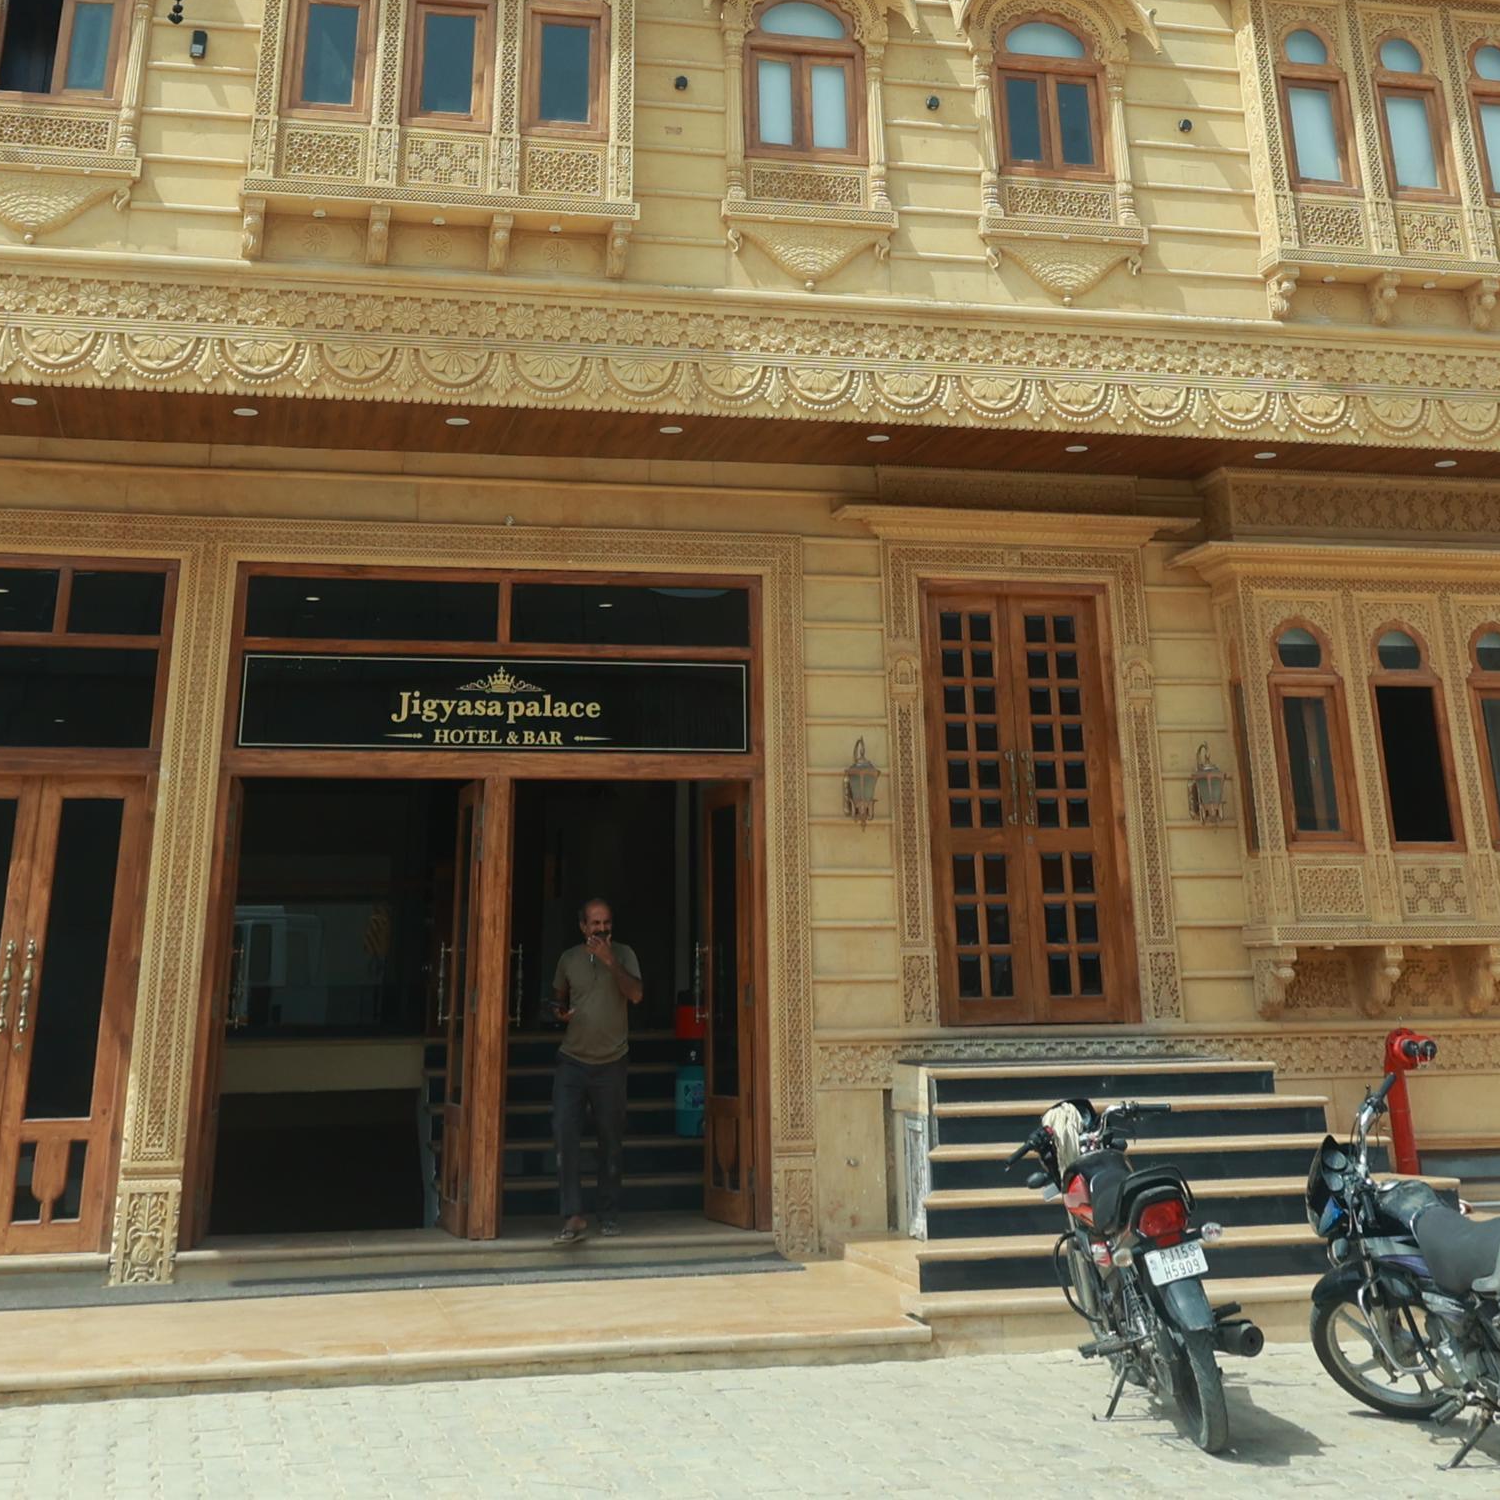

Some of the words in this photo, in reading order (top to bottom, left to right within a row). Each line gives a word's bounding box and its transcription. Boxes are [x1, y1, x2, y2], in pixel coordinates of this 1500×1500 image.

[391, 690, 504, 723] Jigyasa
[506, 694, 601, 724] palace
[433, 729, 503, 744] HOTEL
[506, 731, 520, 744] &
[522, 730, 563, 745] BAR
